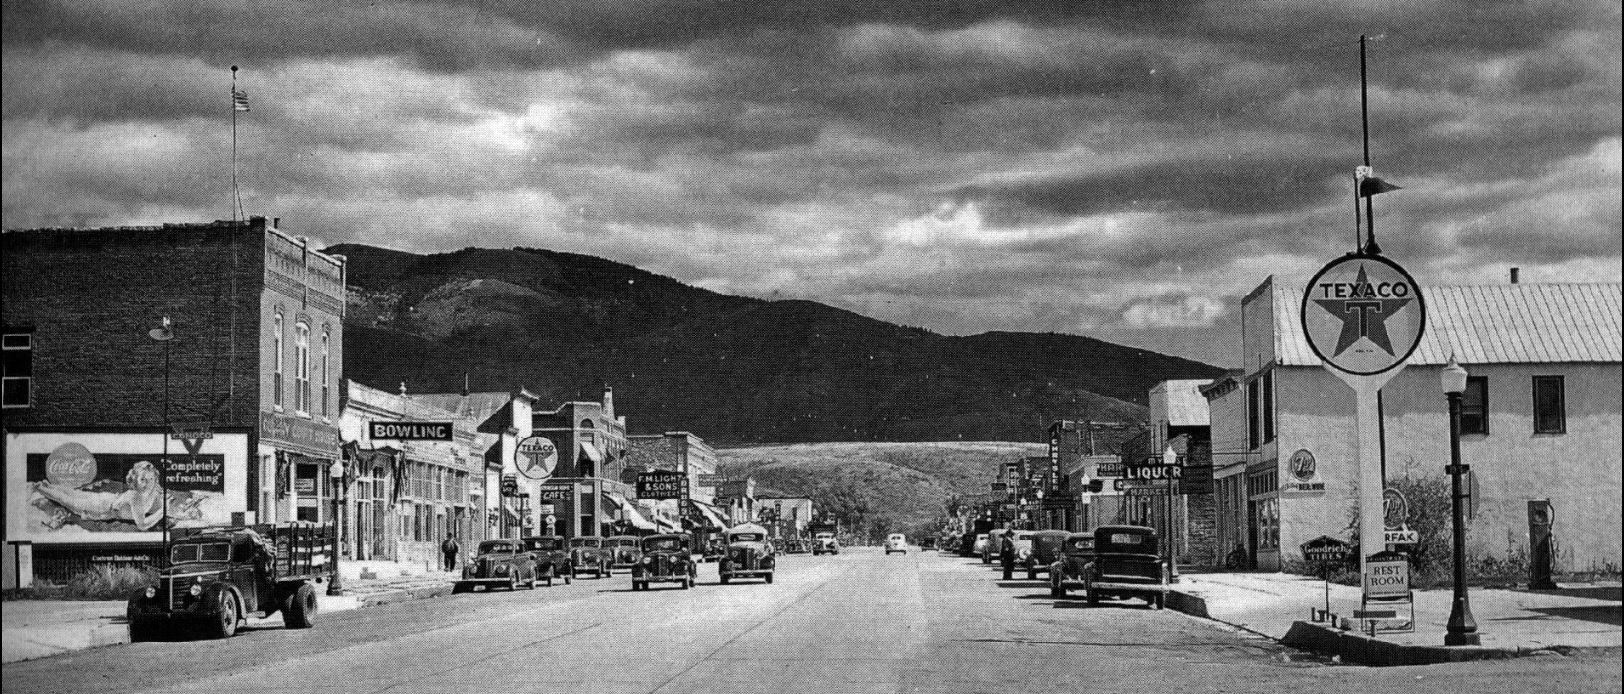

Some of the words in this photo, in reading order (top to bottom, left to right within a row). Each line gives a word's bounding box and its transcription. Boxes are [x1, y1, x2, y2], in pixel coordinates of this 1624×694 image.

[1319, 282, 1408, 299] TEXACO
[374, 424, 447, 438] BOWLING
[522, 444, 555, 452] TEXACO
[1051, 438, 1059, 491] CHRYSLER
[1127, 466, 1182, 480] LIQUOR
[1304, 544, 1345, 554] Goodrich
[1373, 565, 1400, 576] REST
[1370, 577, 1405, 586] ROOM
